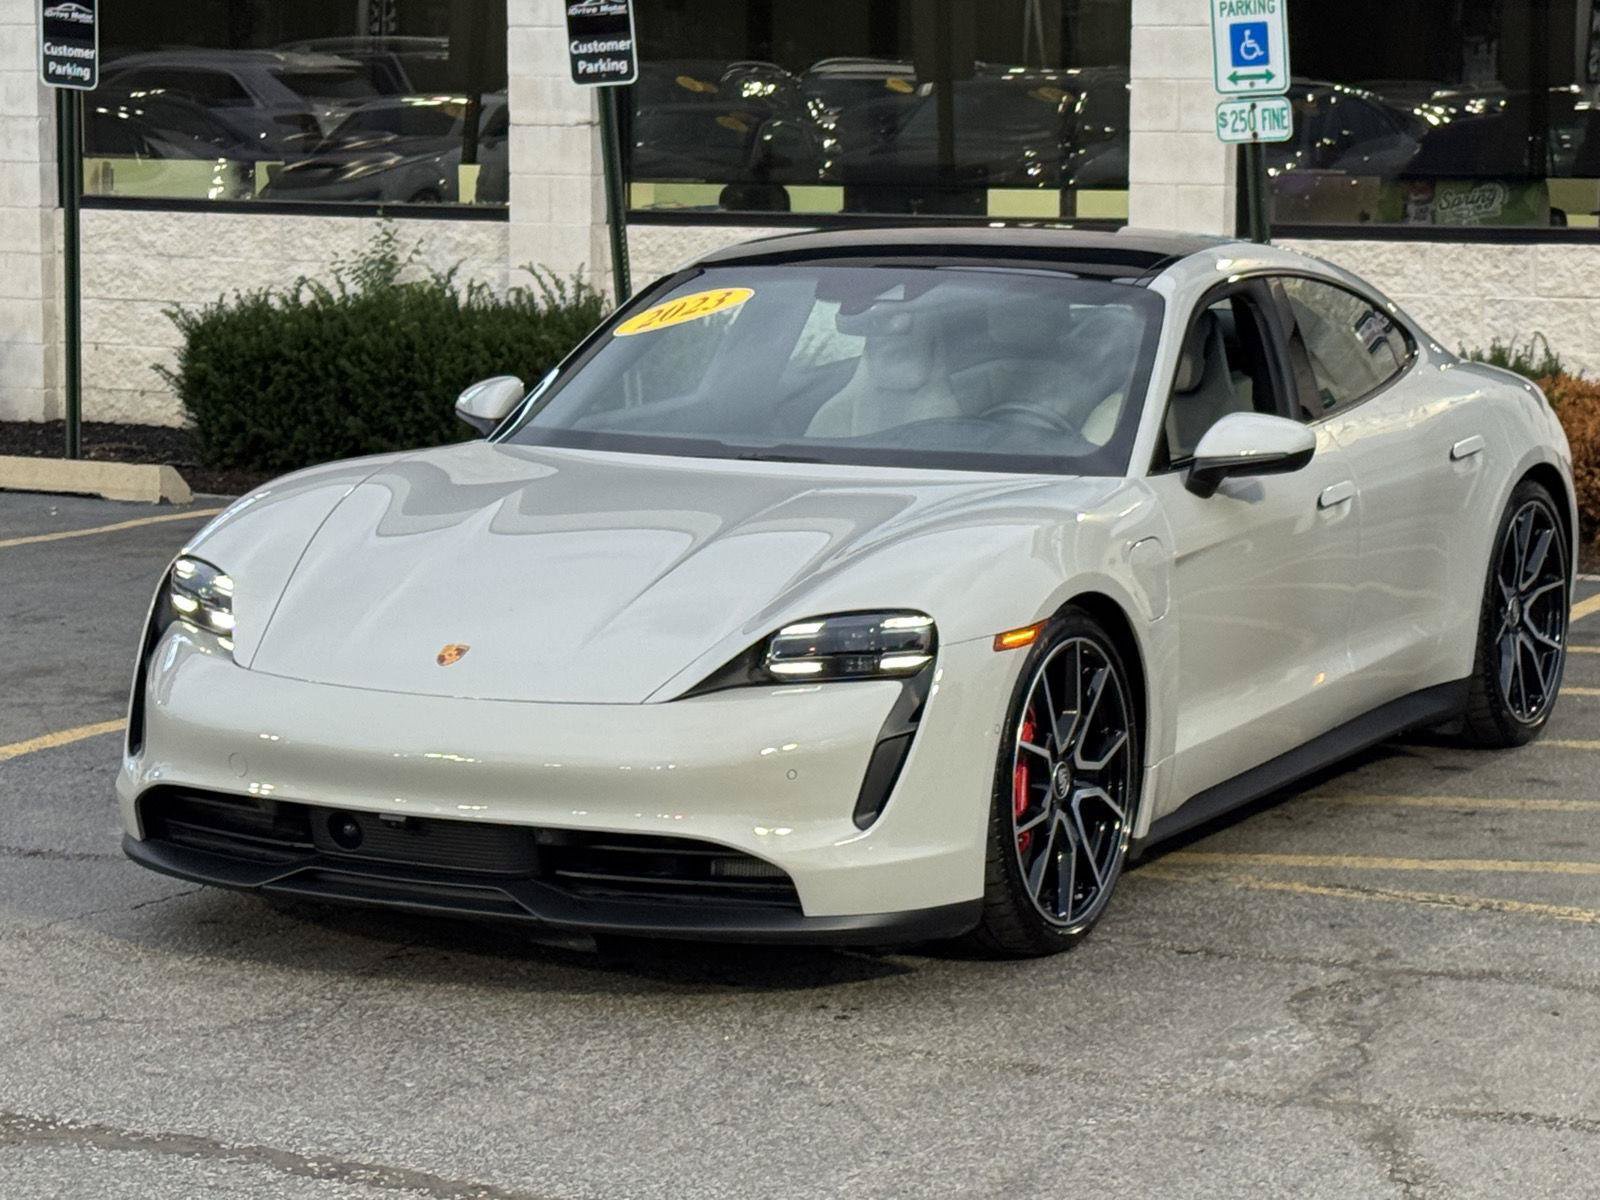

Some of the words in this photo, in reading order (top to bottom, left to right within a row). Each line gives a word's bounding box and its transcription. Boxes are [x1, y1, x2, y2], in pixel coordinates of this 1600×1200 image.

[1219, 0, 1276, 17] PARKING
[44, 42, 96, 59] Customer
[570, 40, 632, 54] Customer
[48, 61, 91, 81] Parking
[578, 58, 628, 75] Parking
[1261, 107, 1288, 131] FINE
[634, 291, 733, 330] 2023
